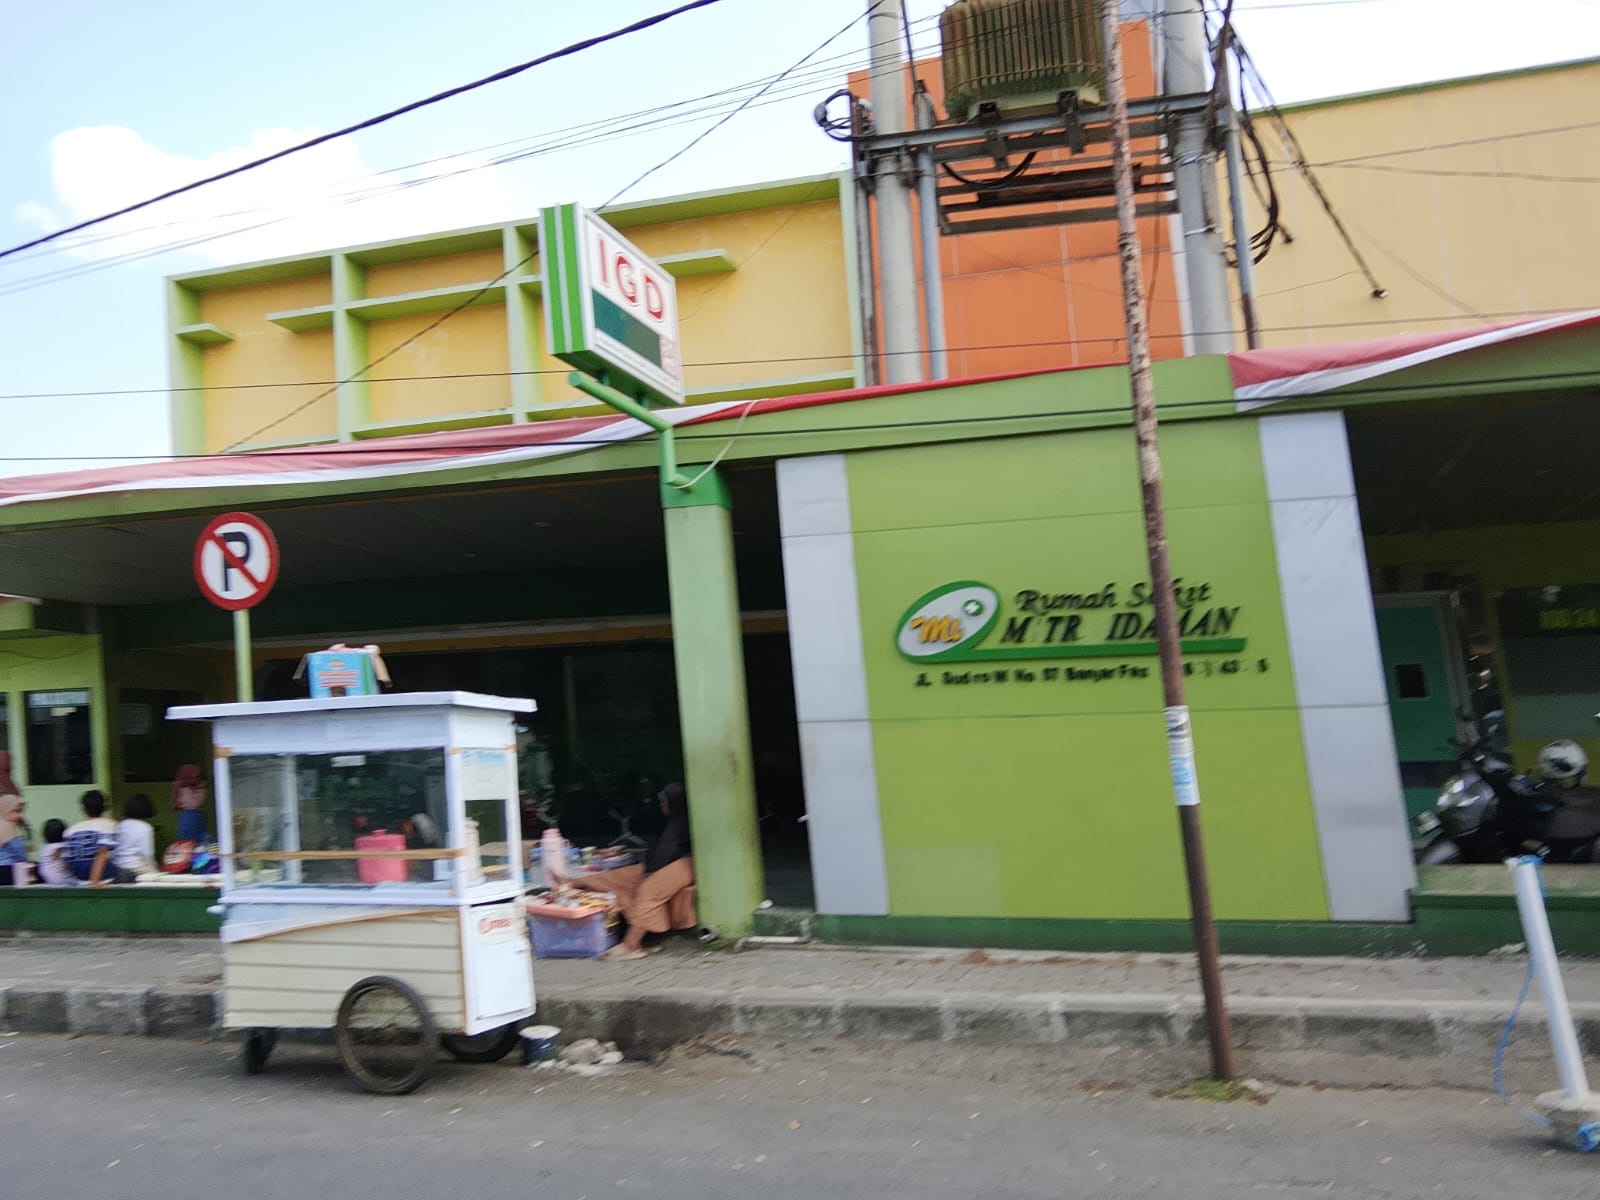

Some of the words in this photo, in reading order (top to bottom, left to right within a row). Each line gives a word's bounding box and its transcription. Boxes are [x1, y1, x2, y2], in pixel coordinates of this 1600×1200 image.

[596, 232, 665, 324] IGD
[222, 531, 251, 592] P
[1016, 582, 1118, 616] Rumah
